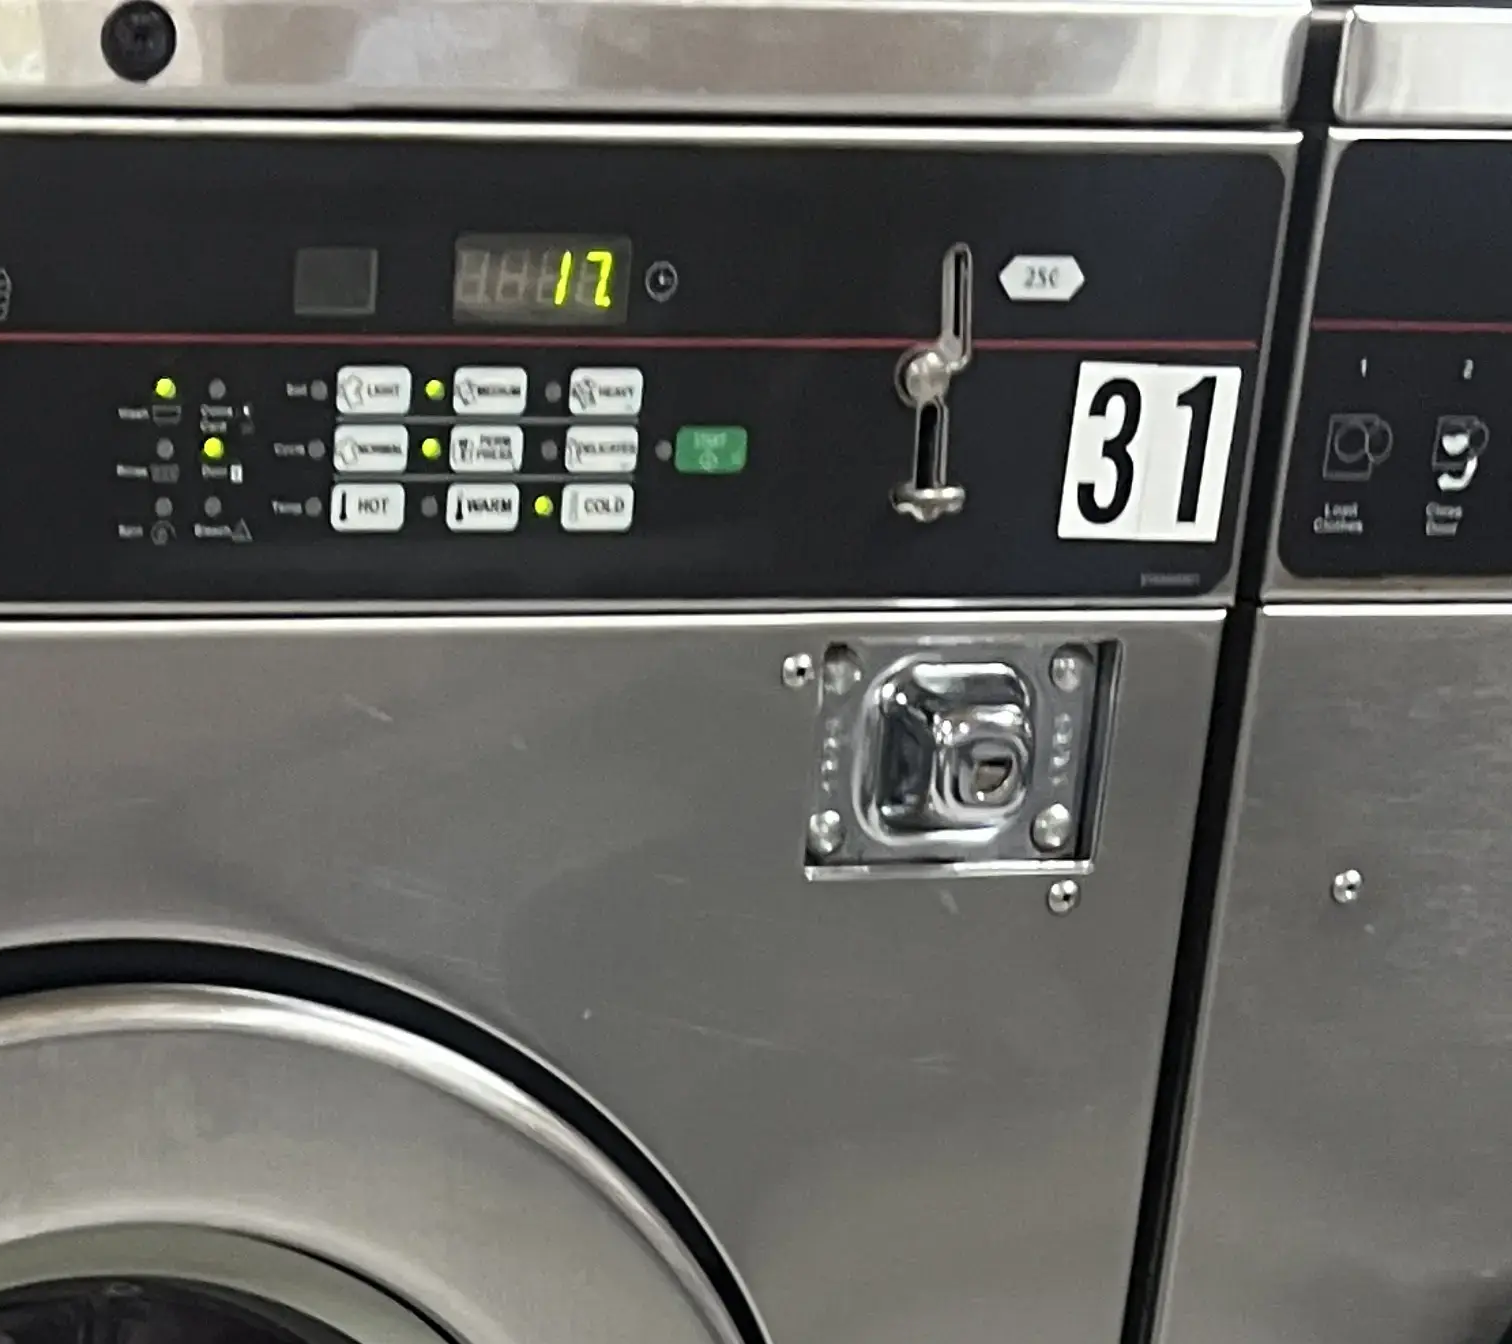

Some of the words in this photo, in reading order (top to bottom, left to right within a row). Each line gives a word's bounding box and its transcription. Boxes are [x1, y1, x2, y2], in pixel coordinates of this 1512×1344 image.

[554, 251, 612, 306] 17
[1076, 375, 1218, 525] 31
[357, 496, 390, 514] HOT
[466, 498, 513, 514] WARM
[583, 497, 625, 515] COLD
